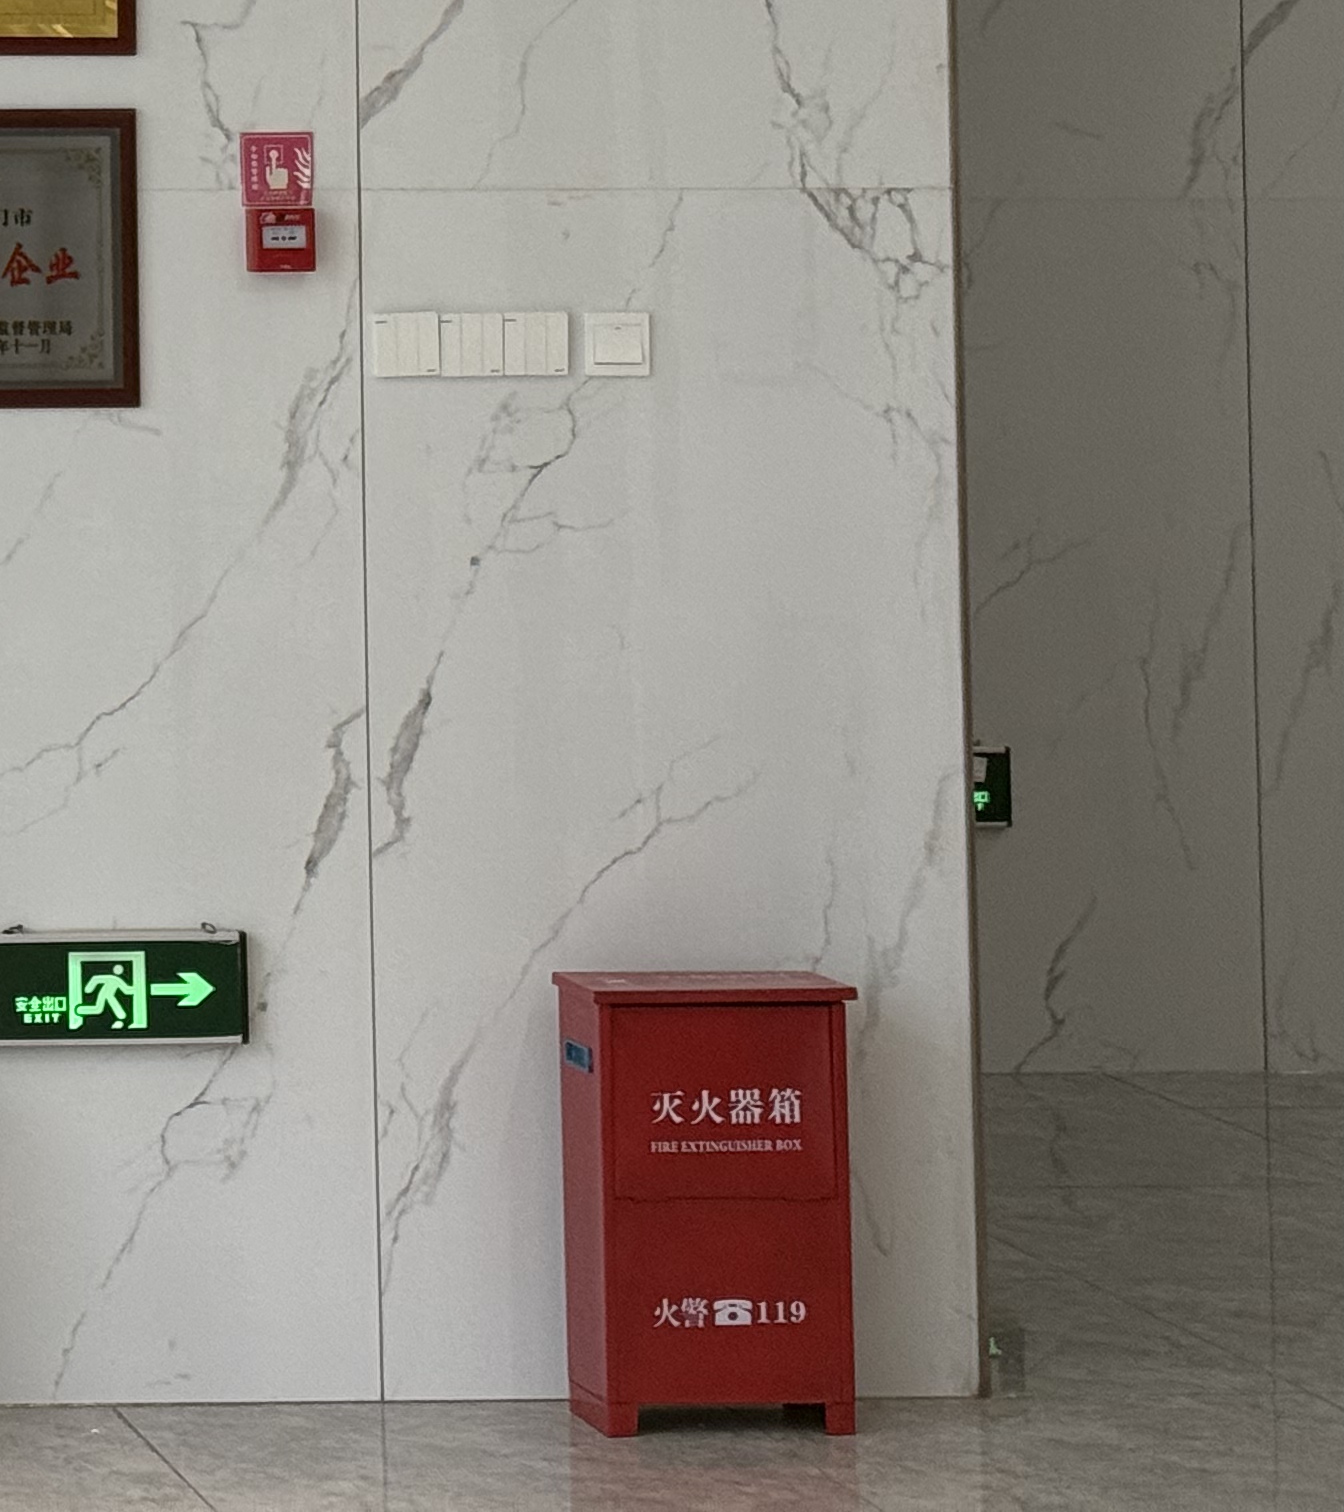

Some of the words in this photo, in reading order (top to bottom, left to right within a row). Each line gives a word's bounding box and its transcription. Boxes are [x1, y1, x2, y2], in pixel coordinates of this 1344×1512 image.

[15, 996, 66, 1013] 安全出口
[24, 1013, 61, 1024] EXIT
[650, 1088, 802, 1125] 灭火器箱
[650, 1141, 679, 1153] FIRE
[680, 1140, 773, 1153] EXTINGUISHER
[776, 1139, 803, 1152] BOX
[653, 1297, 710, 1328] 火警
[757, 1300, 806, 1325] 119
